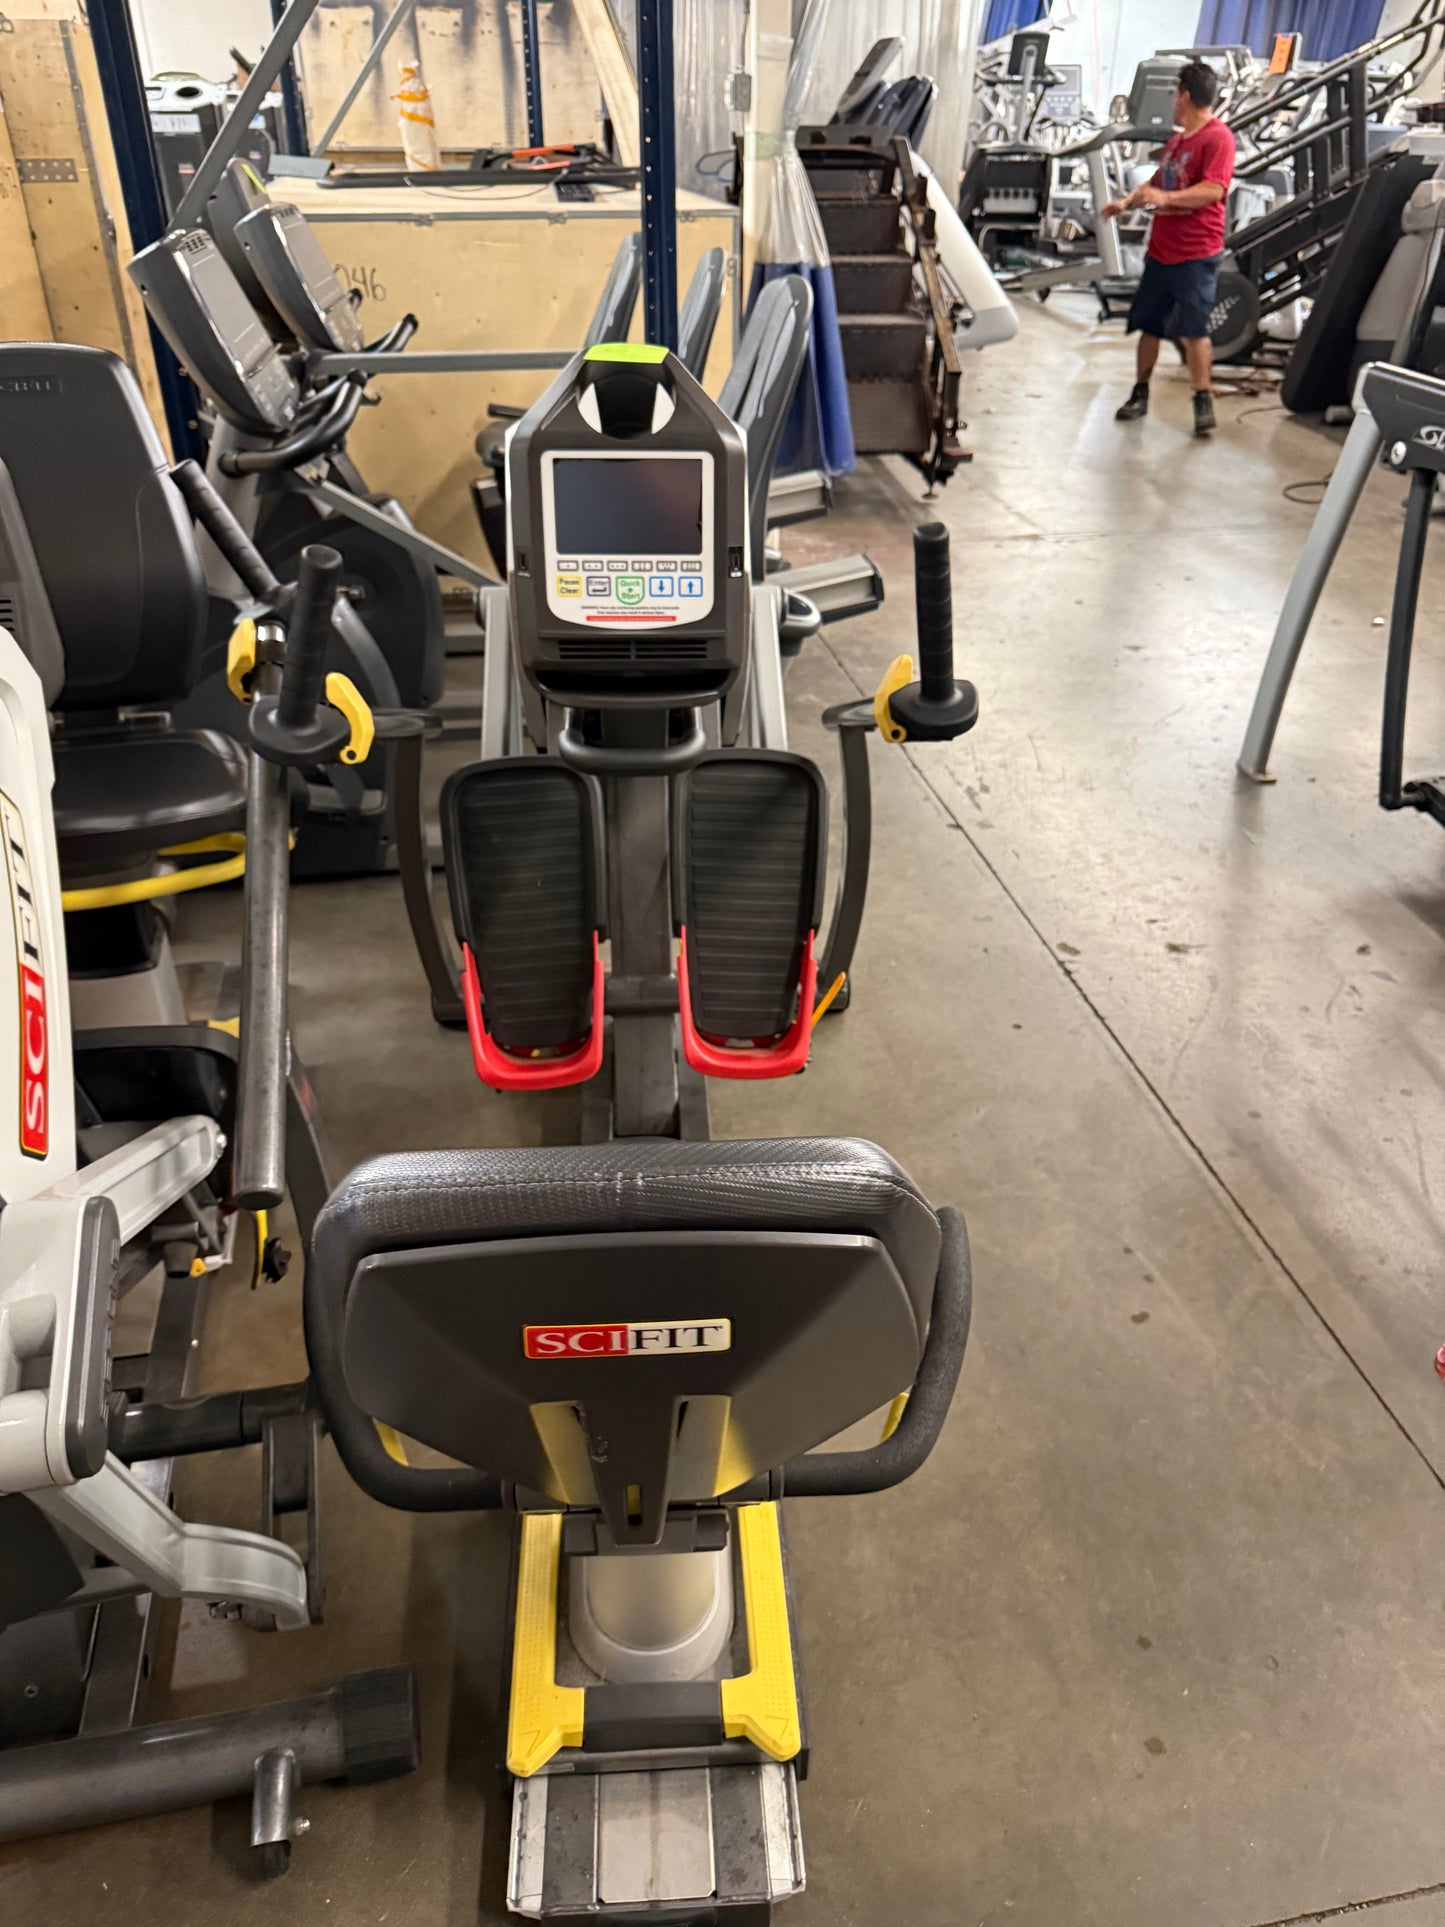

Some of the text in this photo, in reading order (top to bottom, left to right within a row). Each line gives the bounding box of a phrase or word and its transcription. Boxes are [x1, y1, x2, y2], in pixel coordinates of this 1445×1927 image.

[559, 578, 580, 586] Pause
[559, 587, 579, 595] Clear
[4, 812, 46, 1134] SCIFIT
[536, 1325, 723, 1354] SCIFIT
